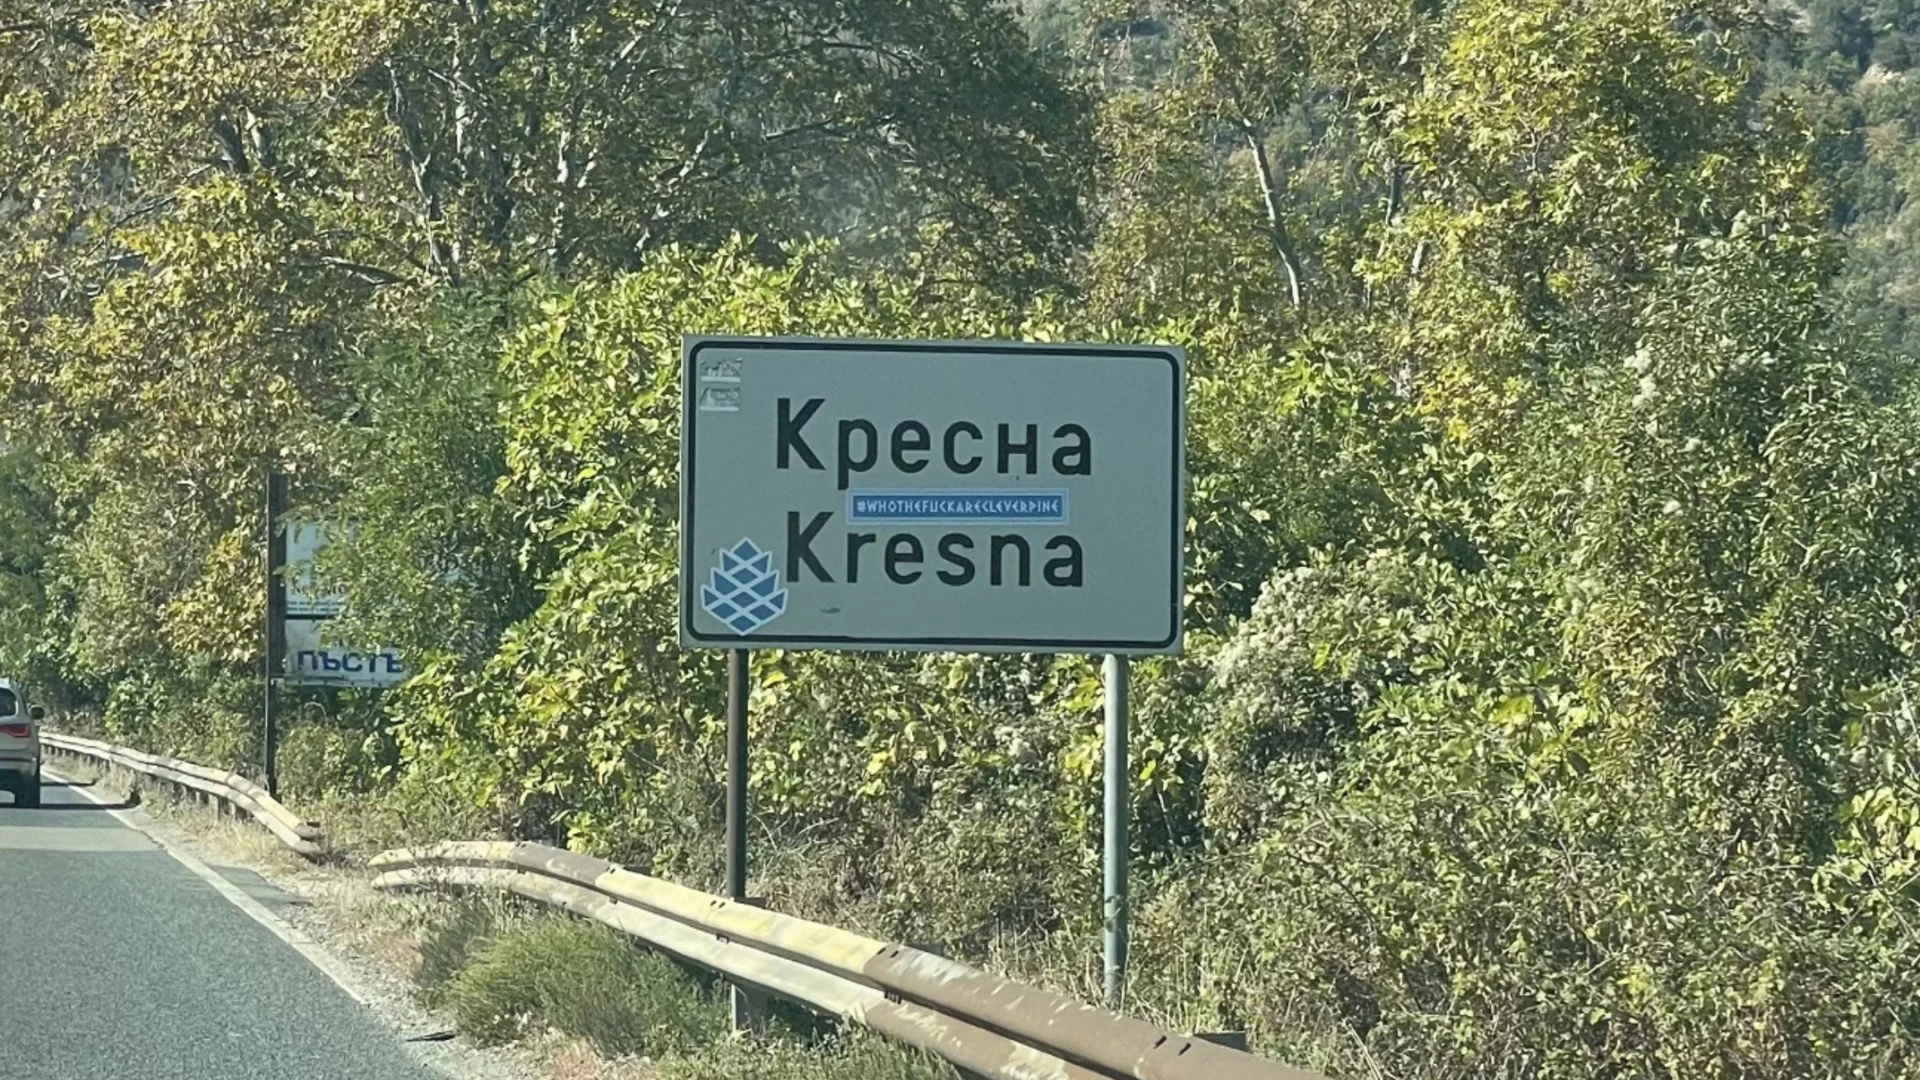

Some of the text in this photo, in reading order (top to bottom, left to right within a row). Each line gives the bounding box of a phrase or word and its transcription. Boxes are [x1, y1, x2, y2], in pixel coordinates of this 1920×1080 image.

[776, 397, 1092, 490] Кресна
[856, 499, 1059, 514] #WHOTHEFUCKARECLEVERPINE
[786, 511, 1084, 587] Kresna
